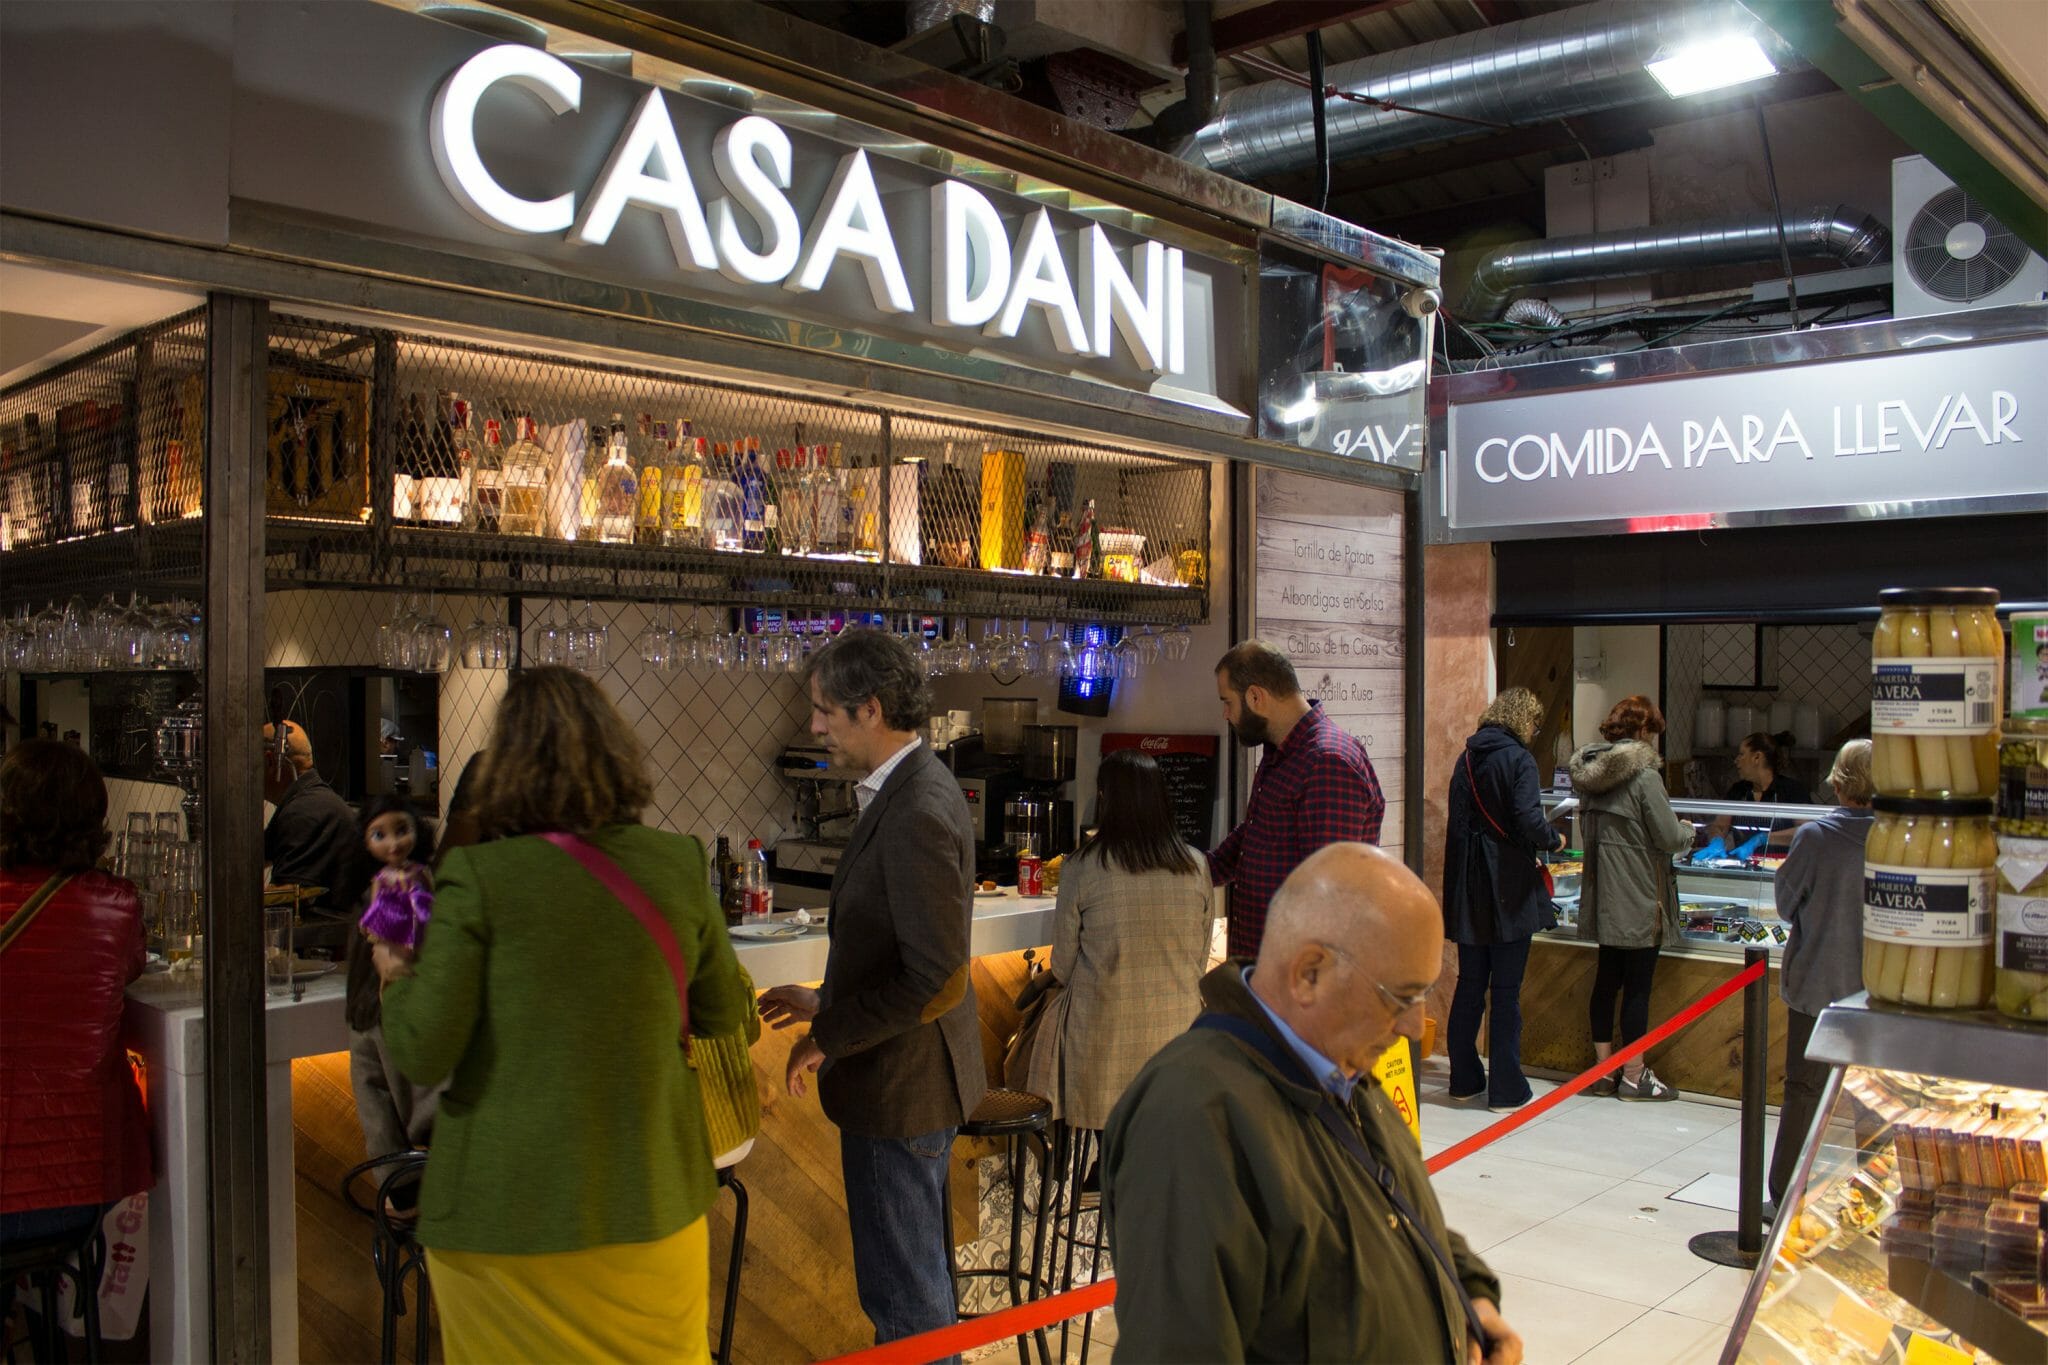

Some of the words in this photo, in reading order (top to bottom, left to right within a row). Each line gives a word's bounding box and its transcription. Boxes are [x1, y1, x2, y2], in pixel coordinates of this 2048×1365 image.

[430, 44, 914, 314] CASA
[931, 179, 1184, 376] DANI
[1475, 420, 1672, 484] COMIDA
[1683, 408, 1813, 468] PARA
[1833, 389, 2022, 457] LLEVAR
[1292, 538, 1325, 561] Tortilla
[1328, 545, 1342, 562] de
[1344, 545, 1375, 566] Patata
[1343, 594, 1355, 609] en
[1358, 592, 1384, 611] Salsa
[1287, 634, 1321, 655] Callos
[1323, 637, 1337, 655] de
[1340, 637, 1350, 655] la
[1353, 637, 1379, 656] Casa
[1352, 682, 1373, 702] Rusa
[1885, 685, 1922, 700] VERA
[1869, 890, 1882, 905] LA
[1885, 892, 1927, 910] VERA
[1386, 1058, 1403, 1069] CAUTION
